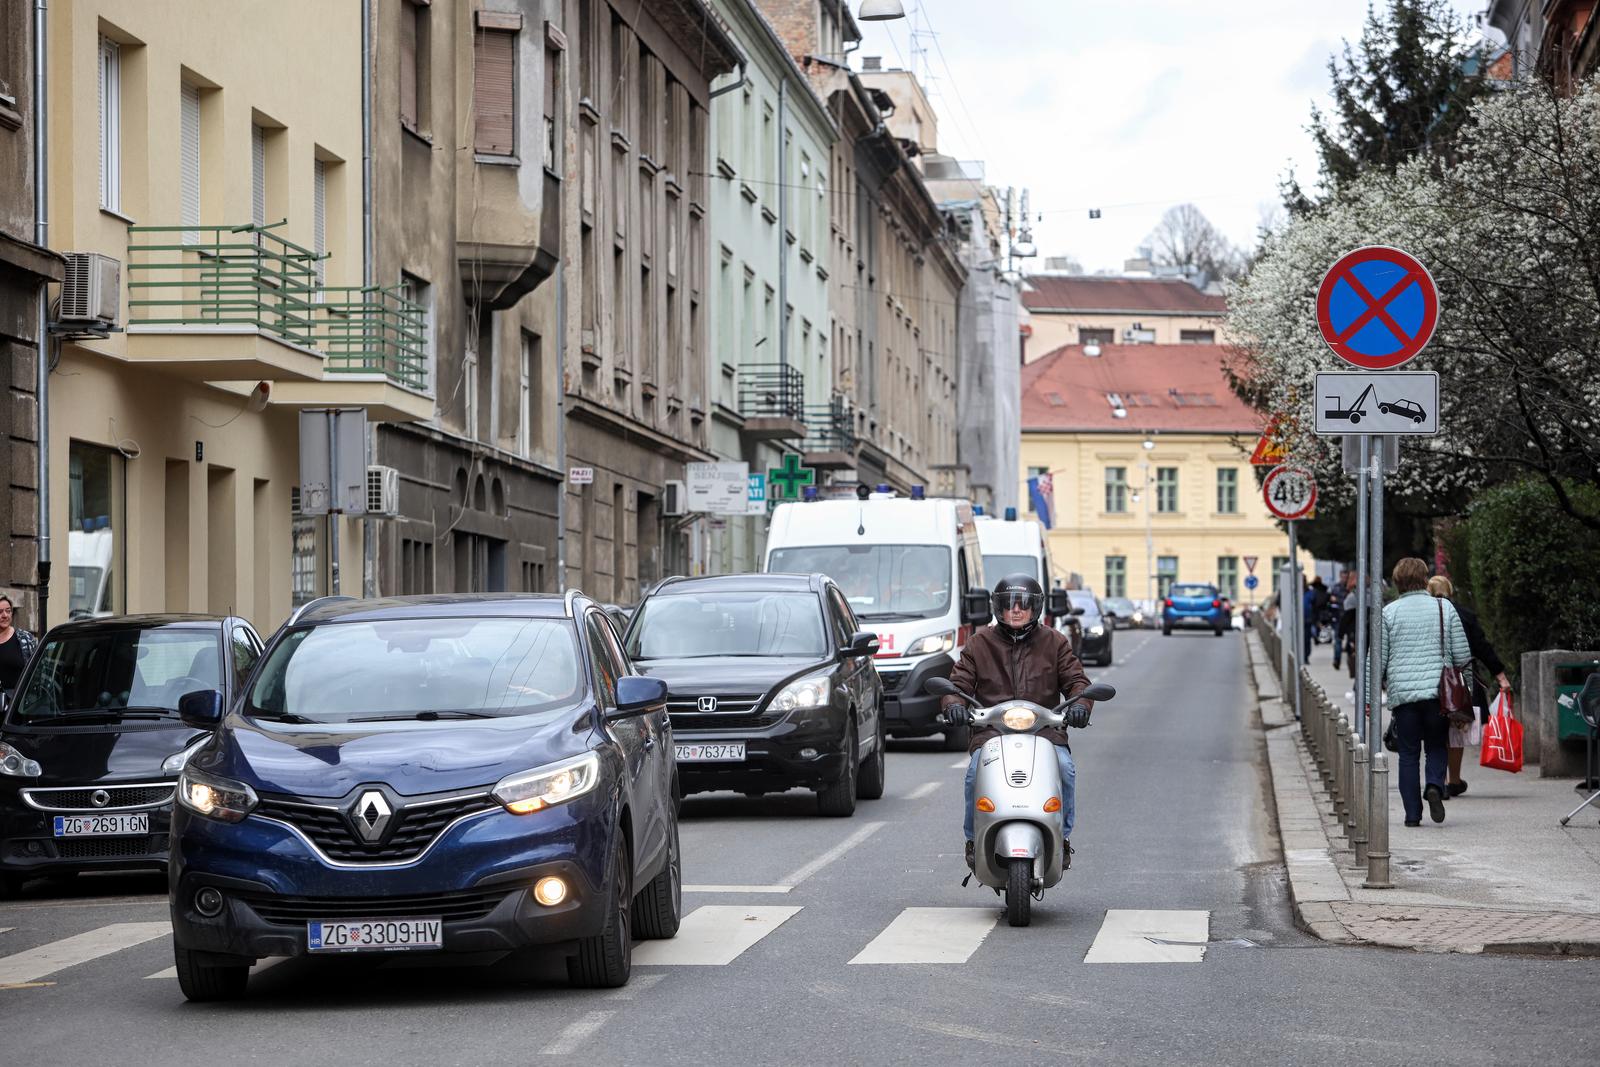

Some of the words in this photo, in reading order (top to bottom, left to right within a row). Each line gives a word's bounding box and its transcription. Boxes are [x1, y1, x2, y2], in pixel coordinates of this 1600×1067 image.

[878, 634, 894, 650] H
[676, 746, 690, 759] ZG
[65, 818, 82, 834] ZG
[323, 924, 348, 945] ZG
